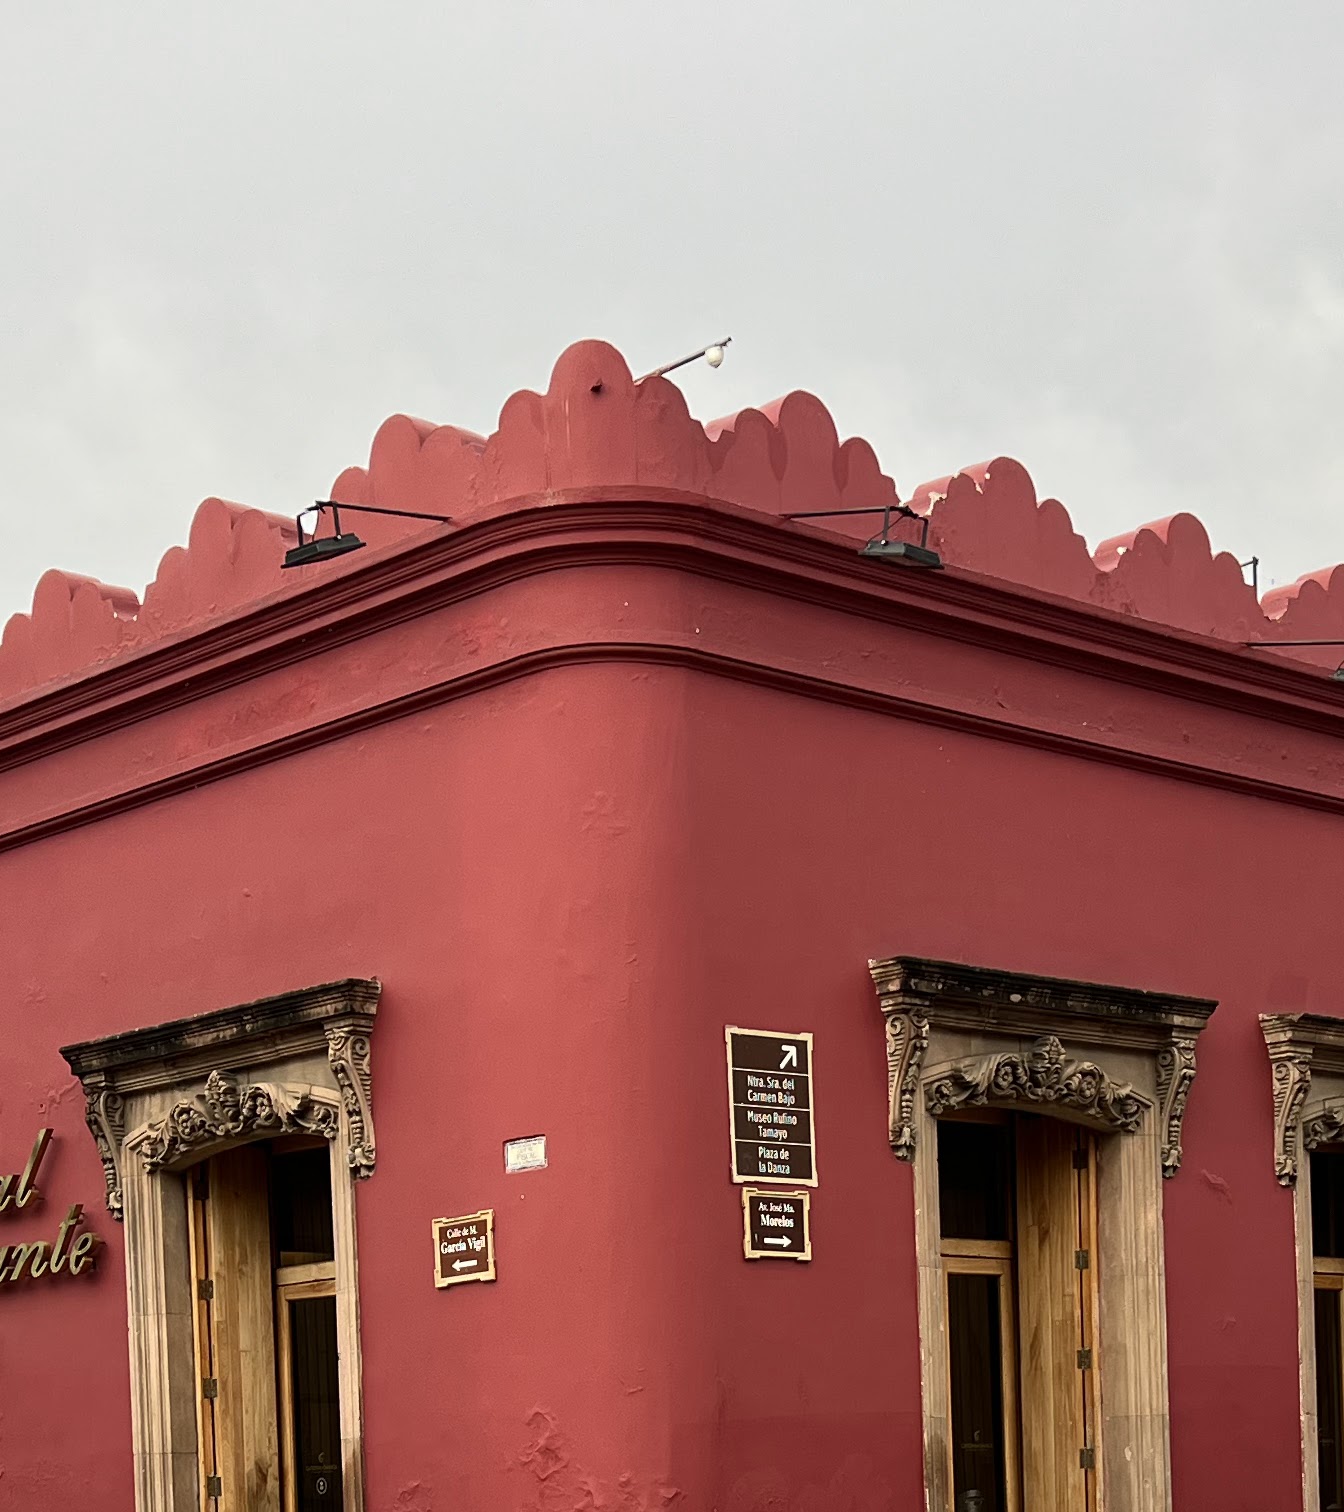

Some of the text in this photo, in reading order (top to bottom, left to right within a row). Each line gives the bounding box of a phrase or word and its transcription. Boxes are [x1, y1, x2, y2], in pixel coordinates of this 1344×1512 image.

[747, 1075, 795, 1090] Ntra. Sra. del
[747, 1089, 796, 1107] Carmen Bajo
[747, 1110, 797, 1126] Museo Rufino
[758, 1125, 788, 1141] Tamayo
[758, 1146, 790, 1161] Plaza de
[758, 1161, 791, 1175] la Danza
[760, 1213, 795, 1228] Morelos
[447, 1228, 461, 1239] Calle
[462, 1227, 469, 1236] de
[441, 1236, 486, 1254] García Vigil
